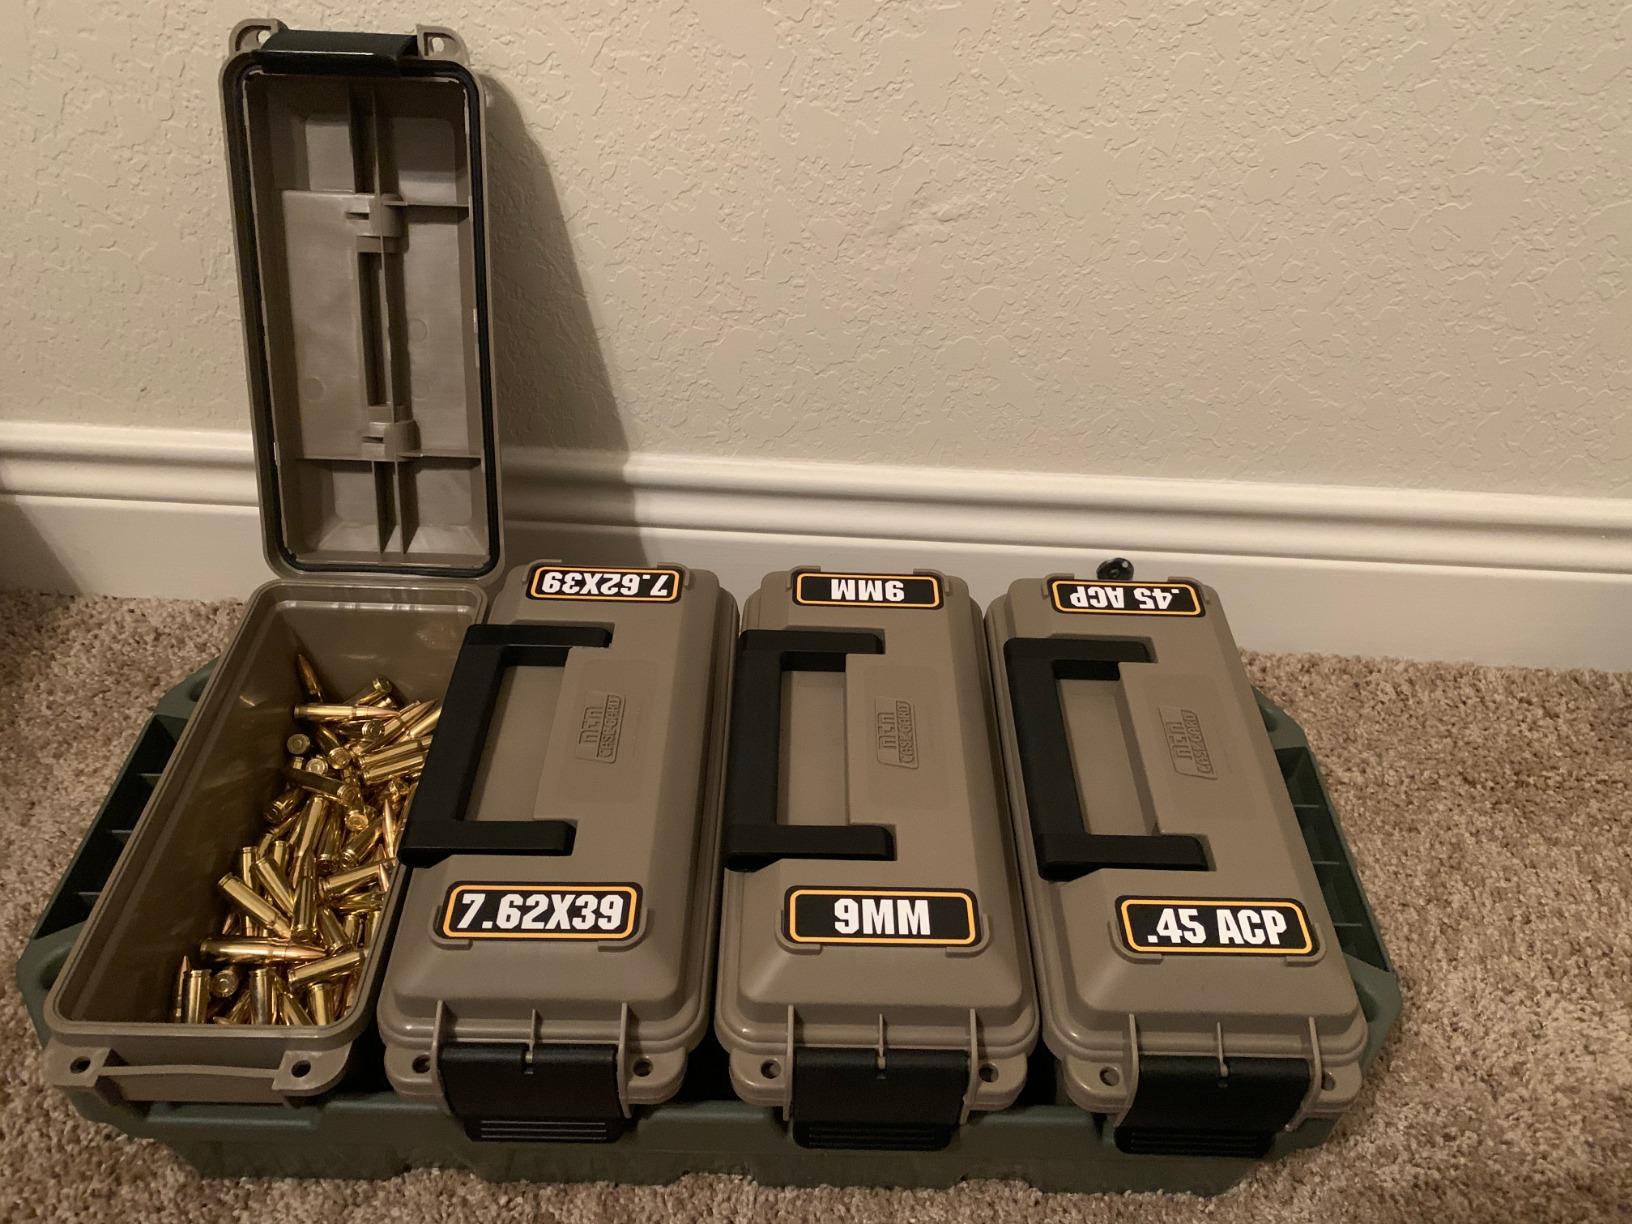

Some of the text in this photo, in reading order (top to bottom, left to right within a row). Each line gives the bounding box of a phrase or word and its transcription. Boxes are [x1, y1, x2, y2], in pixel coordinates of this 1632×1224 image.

[541, 571, 669, 597] 7.62X39
[831, 578, 904, 602] 9MM
[1069, 586, 1180, 610] .45 ACP
[457, 893, 624, 929] 7.62X39
[834, 898, 931, 936] 9MM
[1147, 908, 1287, 945] .45 ACP
